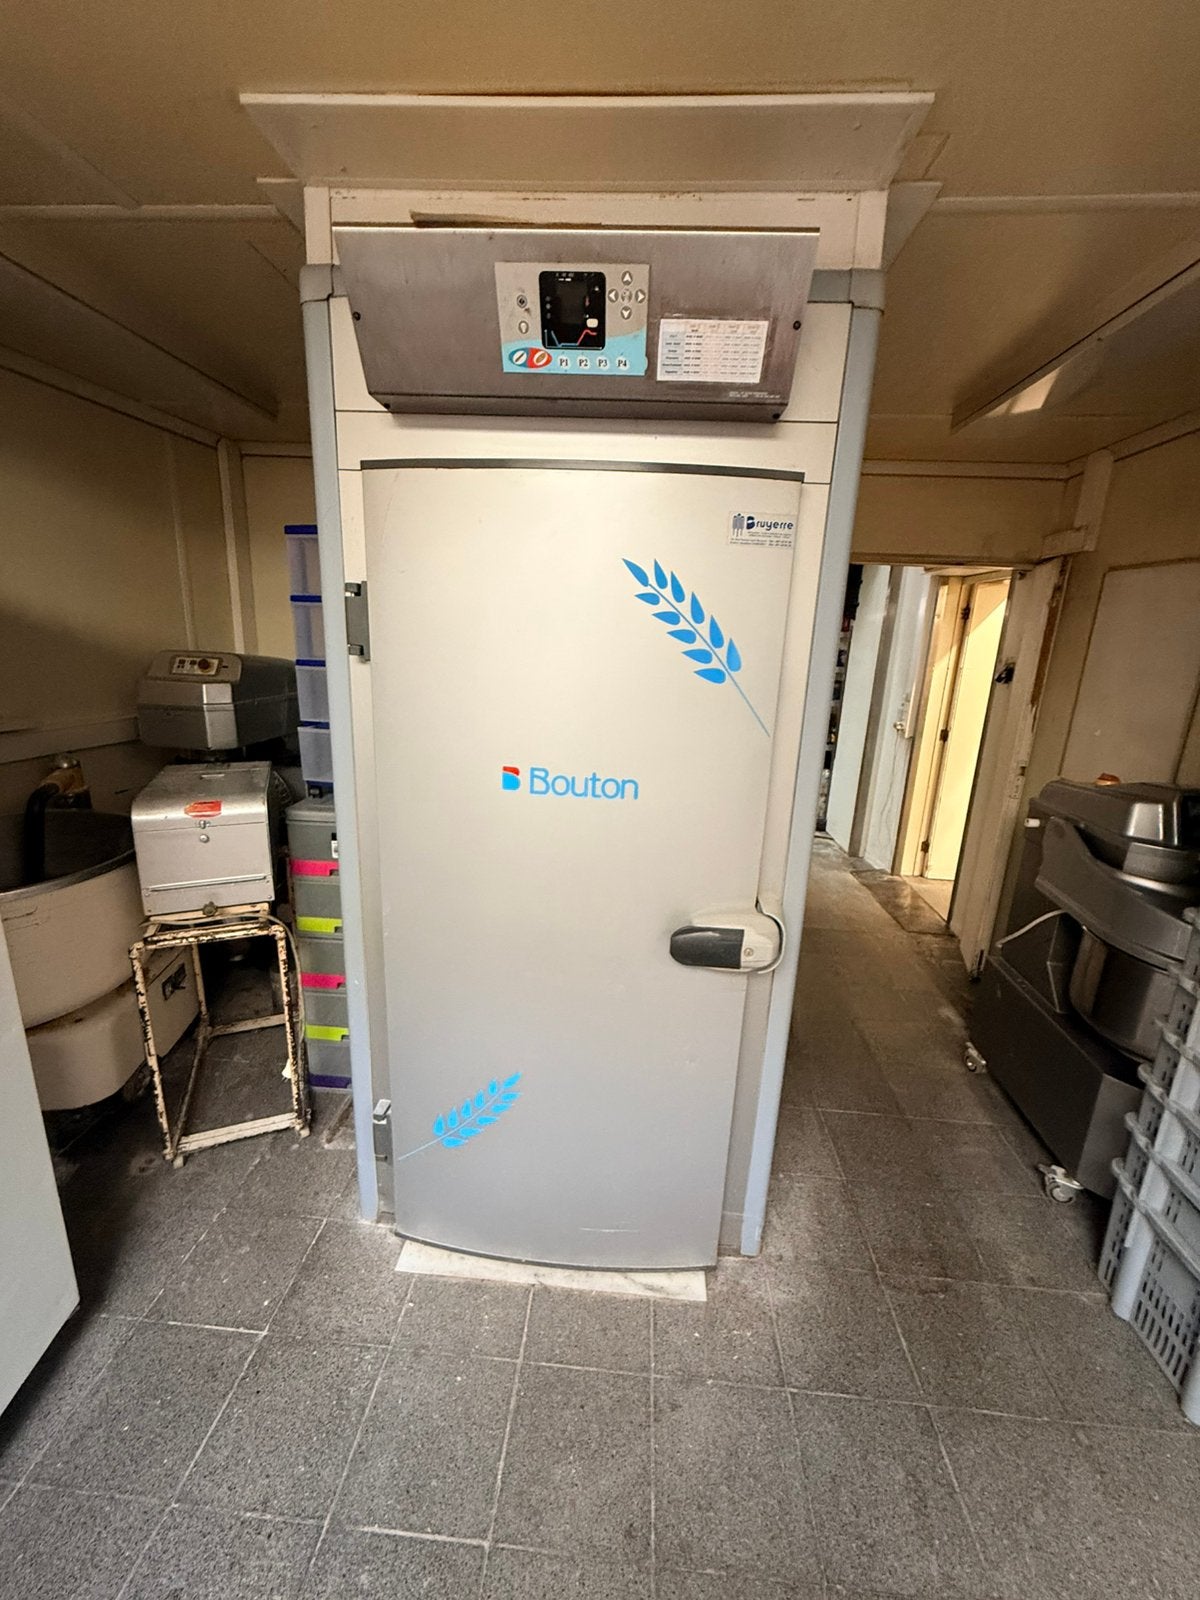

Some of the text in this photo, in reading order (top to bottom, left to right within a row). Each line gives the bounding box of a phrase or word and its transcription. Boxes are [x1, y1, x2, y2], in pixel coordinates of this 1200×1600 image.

[559, 358, 627, 368] P1 P2 P3 P4
[746, 516, 794, 531] Bruyerre
[529, 766, 639, 800] Bouton
